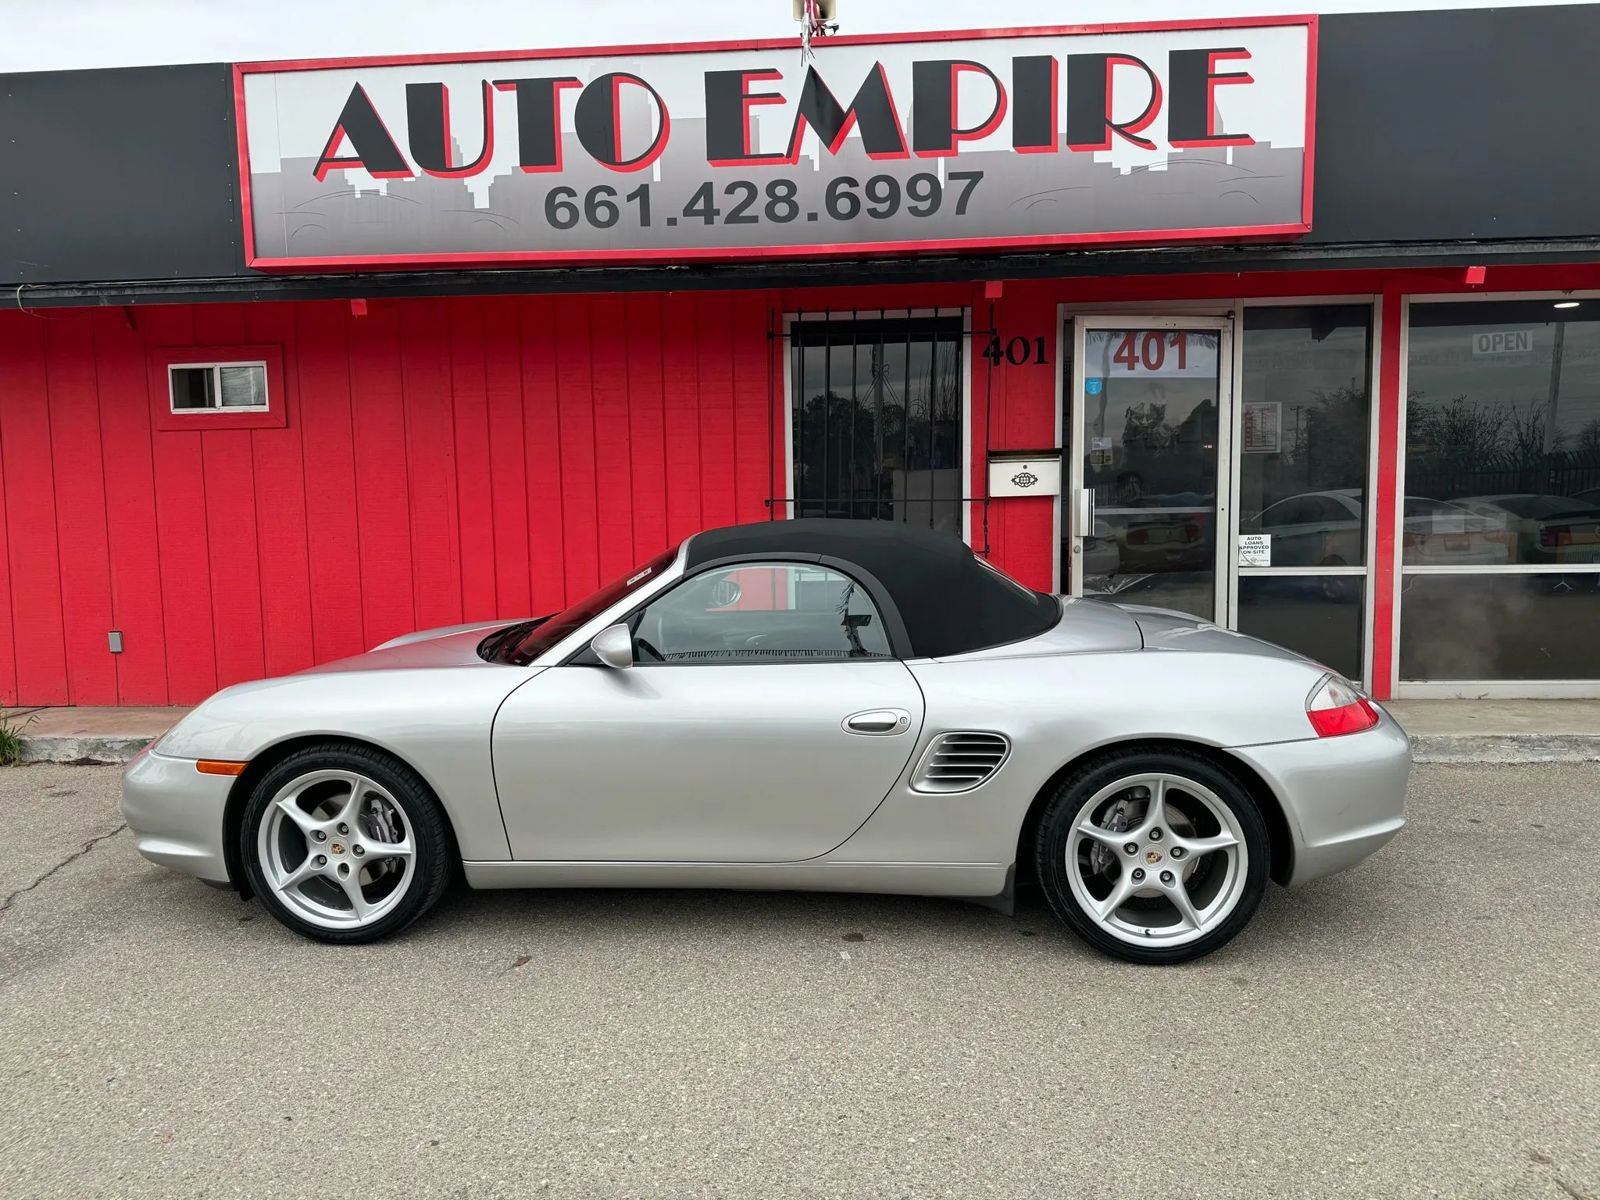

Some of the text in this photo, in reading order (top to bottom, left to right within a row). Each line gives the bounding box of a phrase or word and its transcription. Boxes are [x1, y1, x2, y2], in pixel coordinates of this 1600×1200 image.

[312, 47, 1256, 182] AUTO EMPIRE
[544, 171, 985, 230] 661.428.6997
[982, 335, 1049, 366] 401
[1112, 331, 1188, 371] 401
[1478, 331, 1528, 352] OPEN
